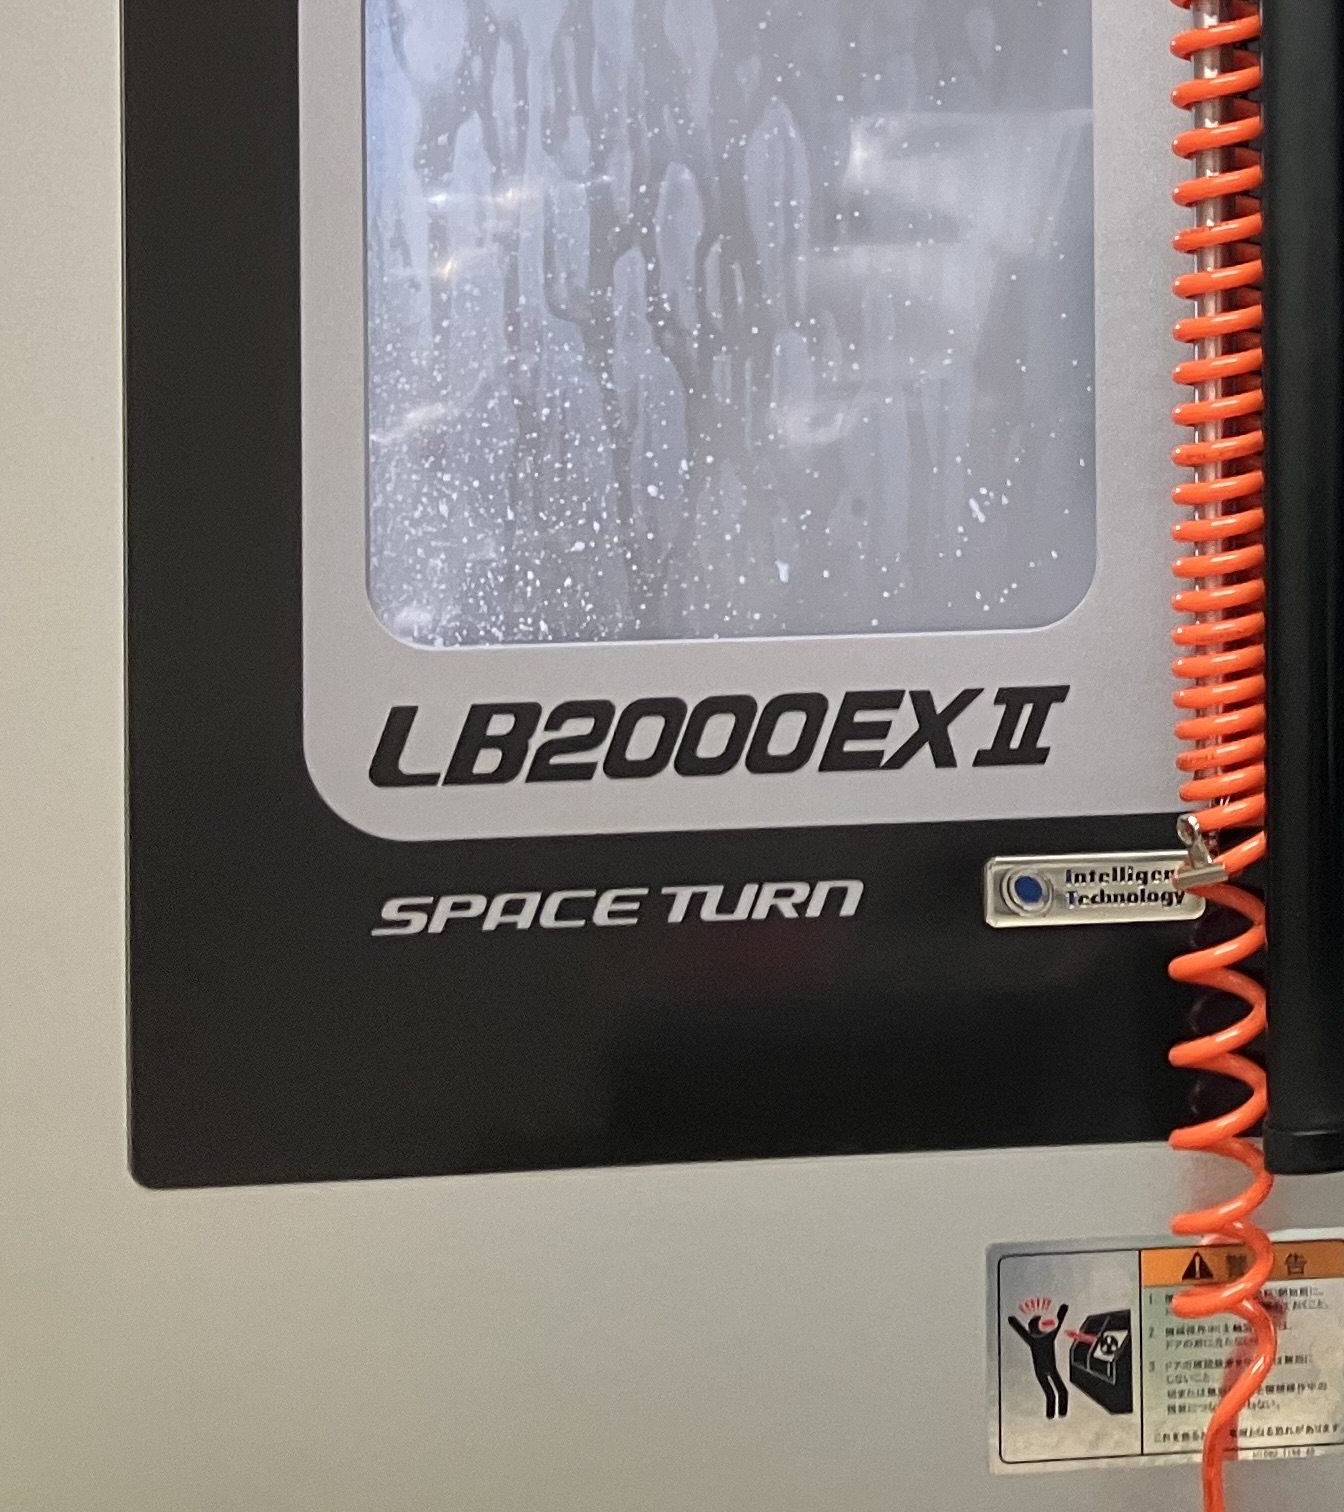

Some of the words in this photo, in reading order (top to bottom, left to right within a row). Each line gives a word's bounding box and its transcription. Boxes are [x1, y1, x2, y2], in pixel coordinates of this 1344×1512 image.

[368, 687, 983, 788] LB2000EX
[372, 889, 640, 936] SPACE
[654, 880, 865, 924] TURN
[1067, 888, 1185, 908] Technology
